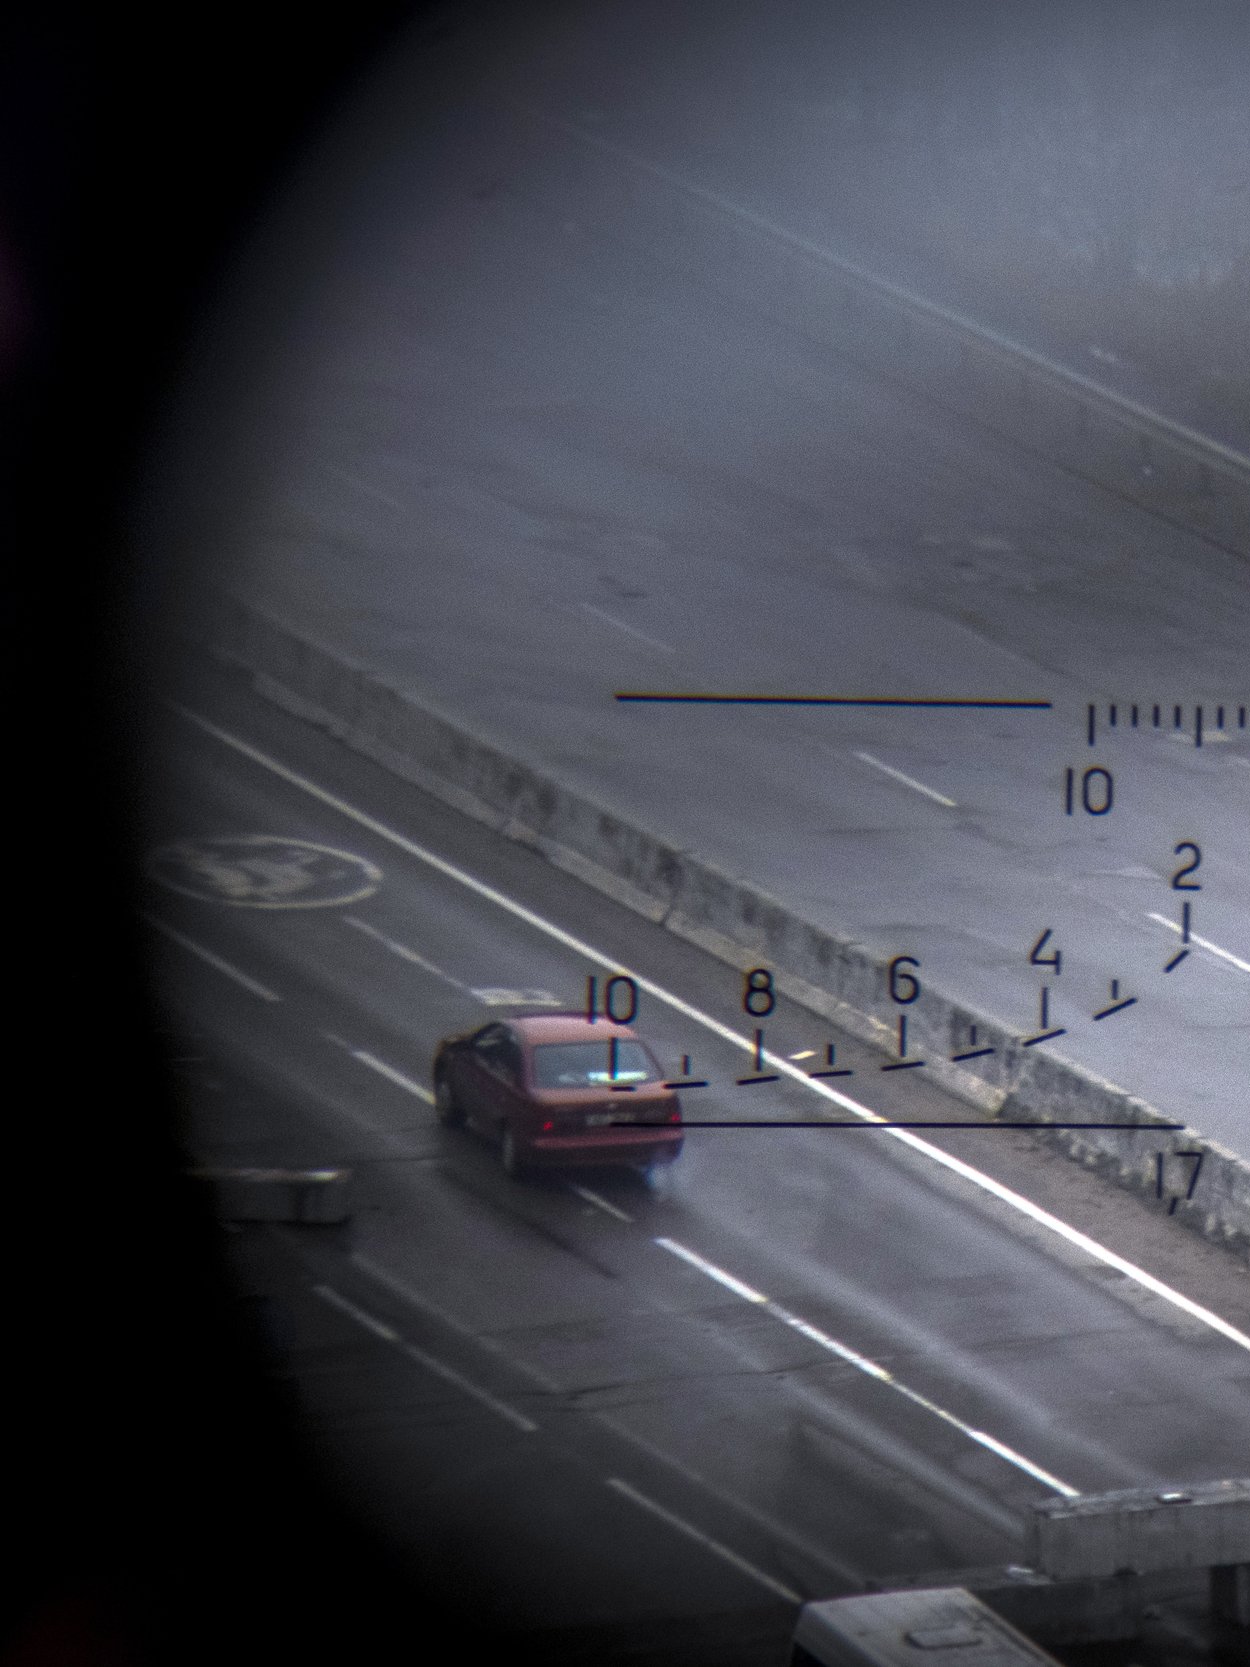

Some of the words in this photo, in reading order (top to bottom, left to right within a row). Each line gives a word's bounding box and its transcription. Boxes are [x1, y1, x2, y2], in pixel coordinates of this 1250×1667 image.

[1066, 768, 1114, 816] 10
[1172, 841, 1202, 891] 2
[1029, 929, 1062, 976] 4
[587, 974, 639, 1024] 10
[743, 968, 776, 1017] 8
[889, 956, 921, 1005] 6
